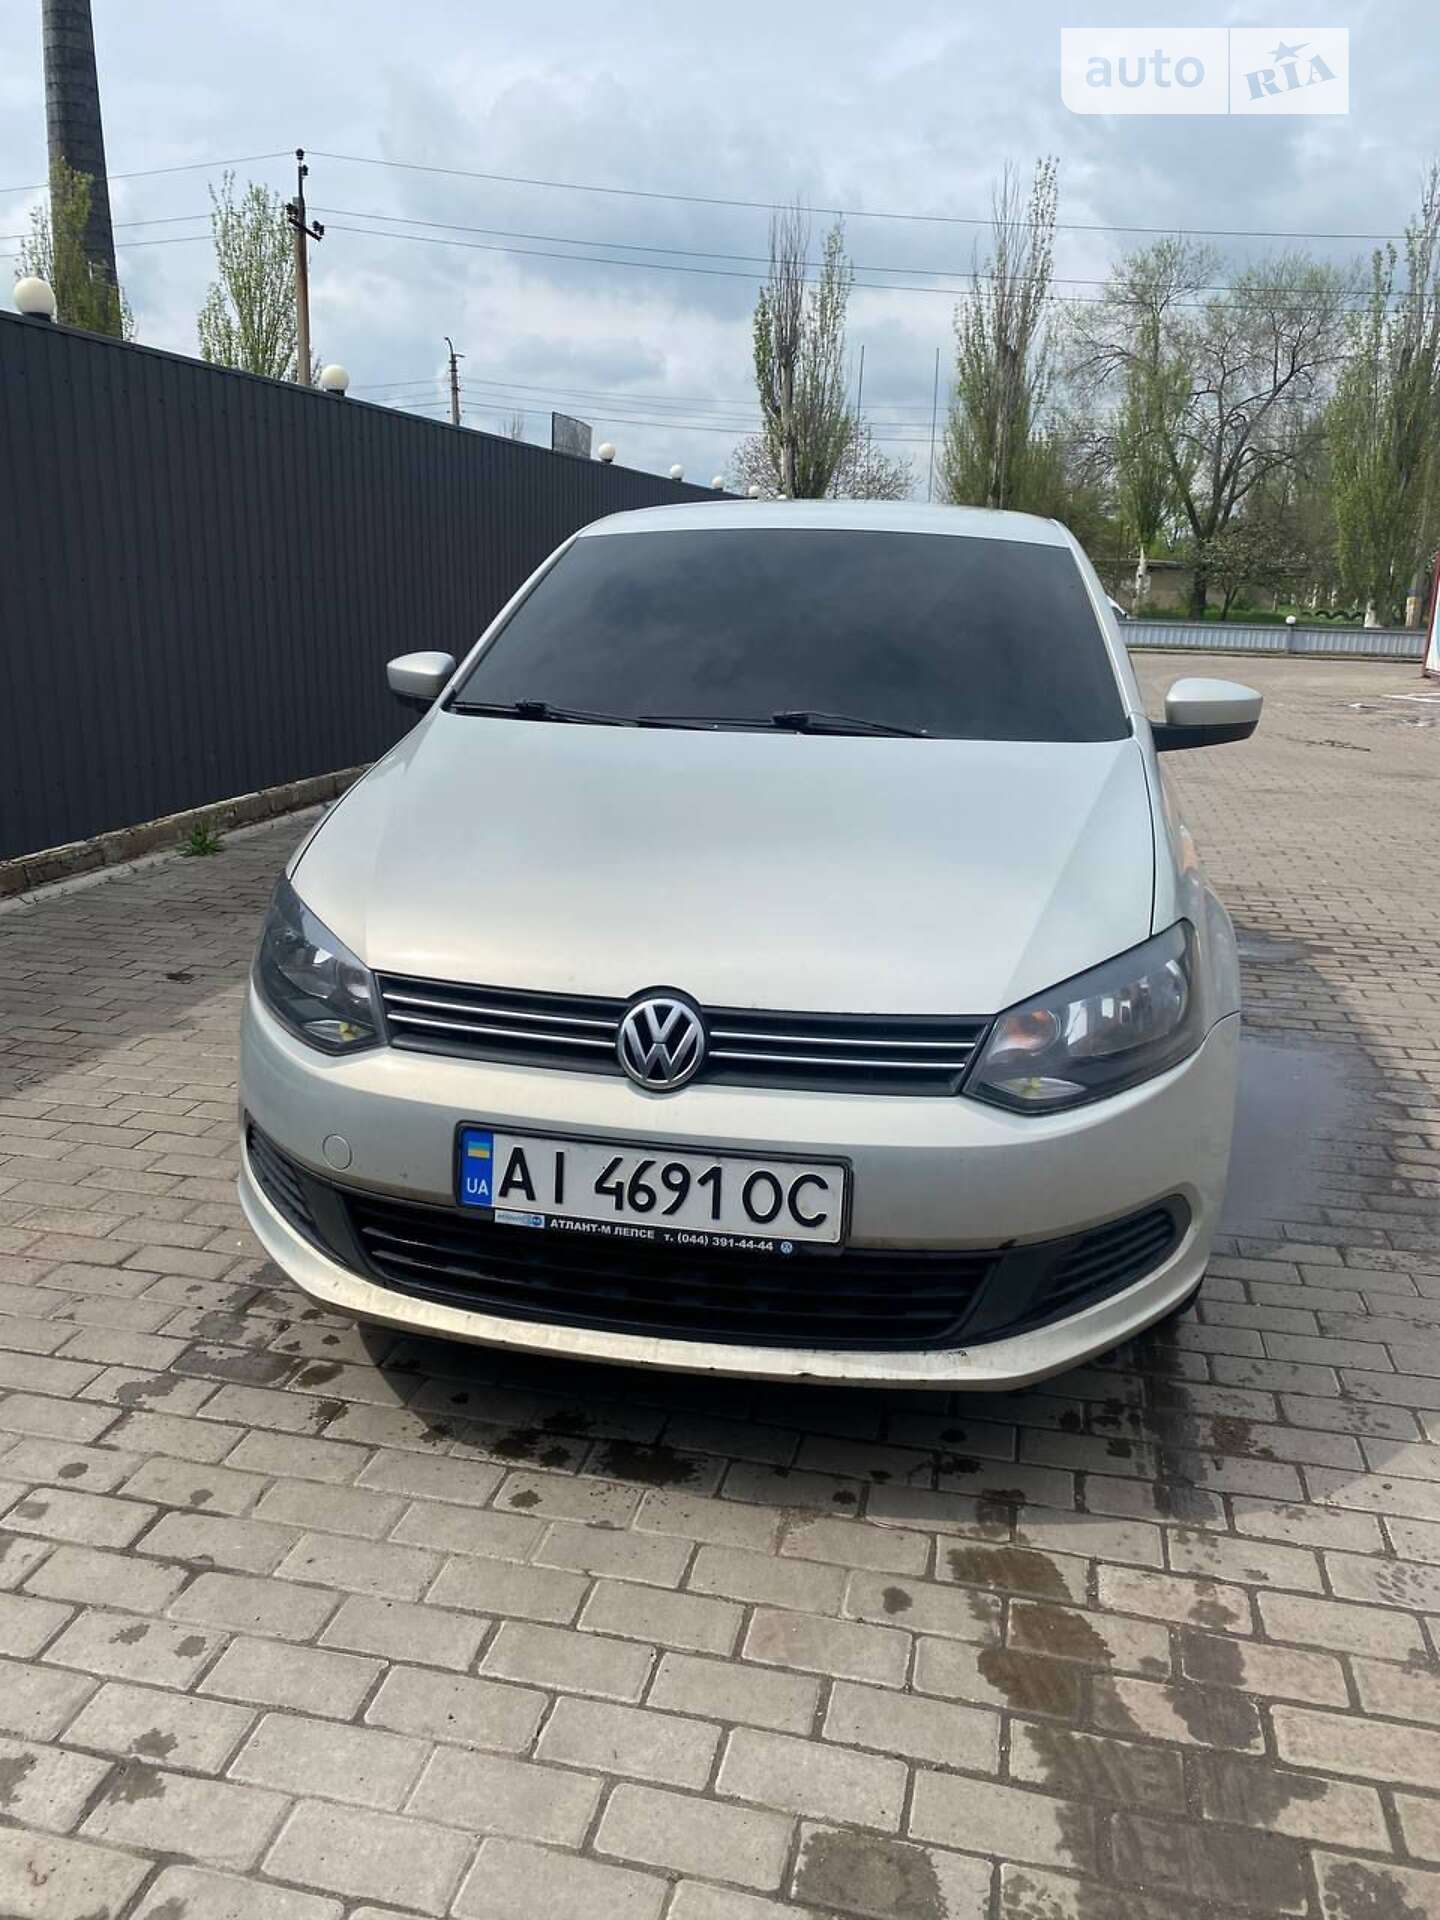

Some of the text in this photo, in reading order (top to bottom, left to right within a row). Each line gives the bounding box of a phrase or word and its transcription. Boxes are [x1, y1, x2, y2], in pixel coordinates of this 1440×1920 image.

[621, 1000, 701, 1084] VW
[466, 1177, 490, 1196] UA
[498, 1146, 829, 1228] AI 4691 OC
[550, 1218, 612, 1235] АТЛАНТ-М
[613, 1226, 655, 1240] ЛЕПСЕ
[677, 1231, 709, 1247] (044)
